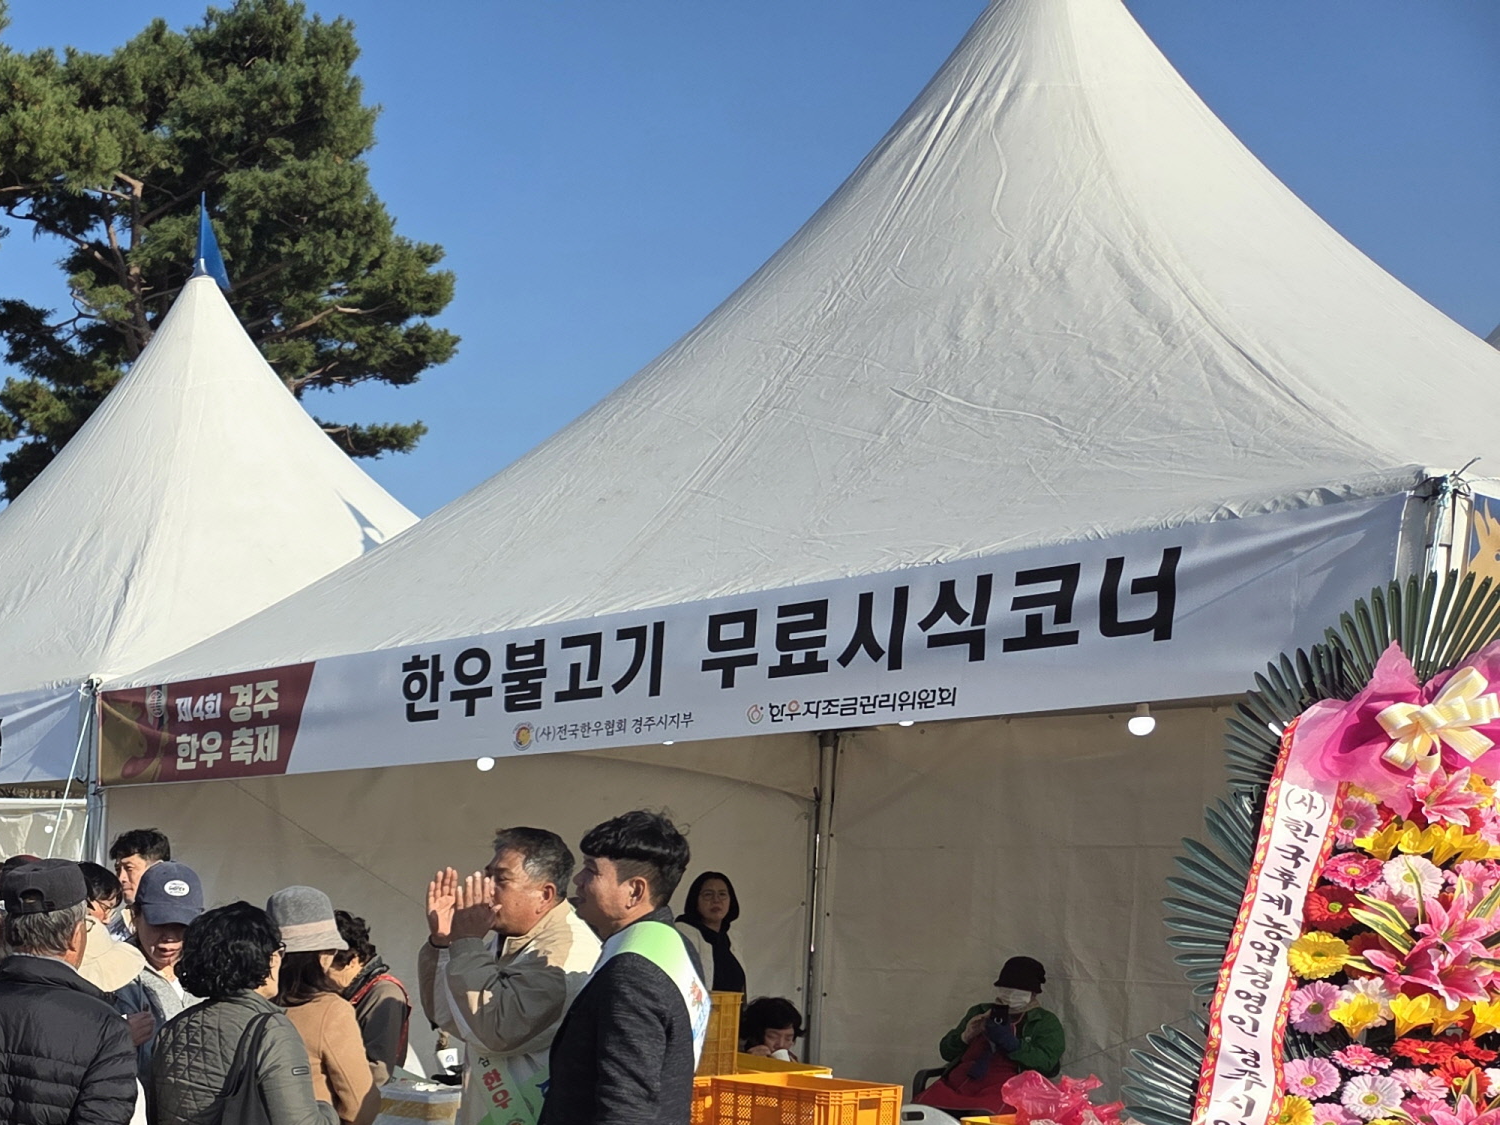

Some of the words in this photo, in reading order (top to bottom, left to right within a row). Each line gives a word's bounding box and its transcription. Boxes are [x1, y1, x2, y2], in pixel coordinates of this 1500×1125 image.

[402, 621, 665, 722] 한우불고기
[700, 546, 1183, 689] 무료시식코너
[175, 692, 222, 722] 제4회
[229, 680, 279, 722] 경주
[768, 686, 958, 723] 한우자조금관리위원회
[176, 731, 222, 770] 한우
[229, 725, 280, 765] 축제
[534, 718, 627, 743] (사)전국한우협회
[631, 711, 695, 736] 경주시지부
[482, 1068, 513, 1109] 한우
